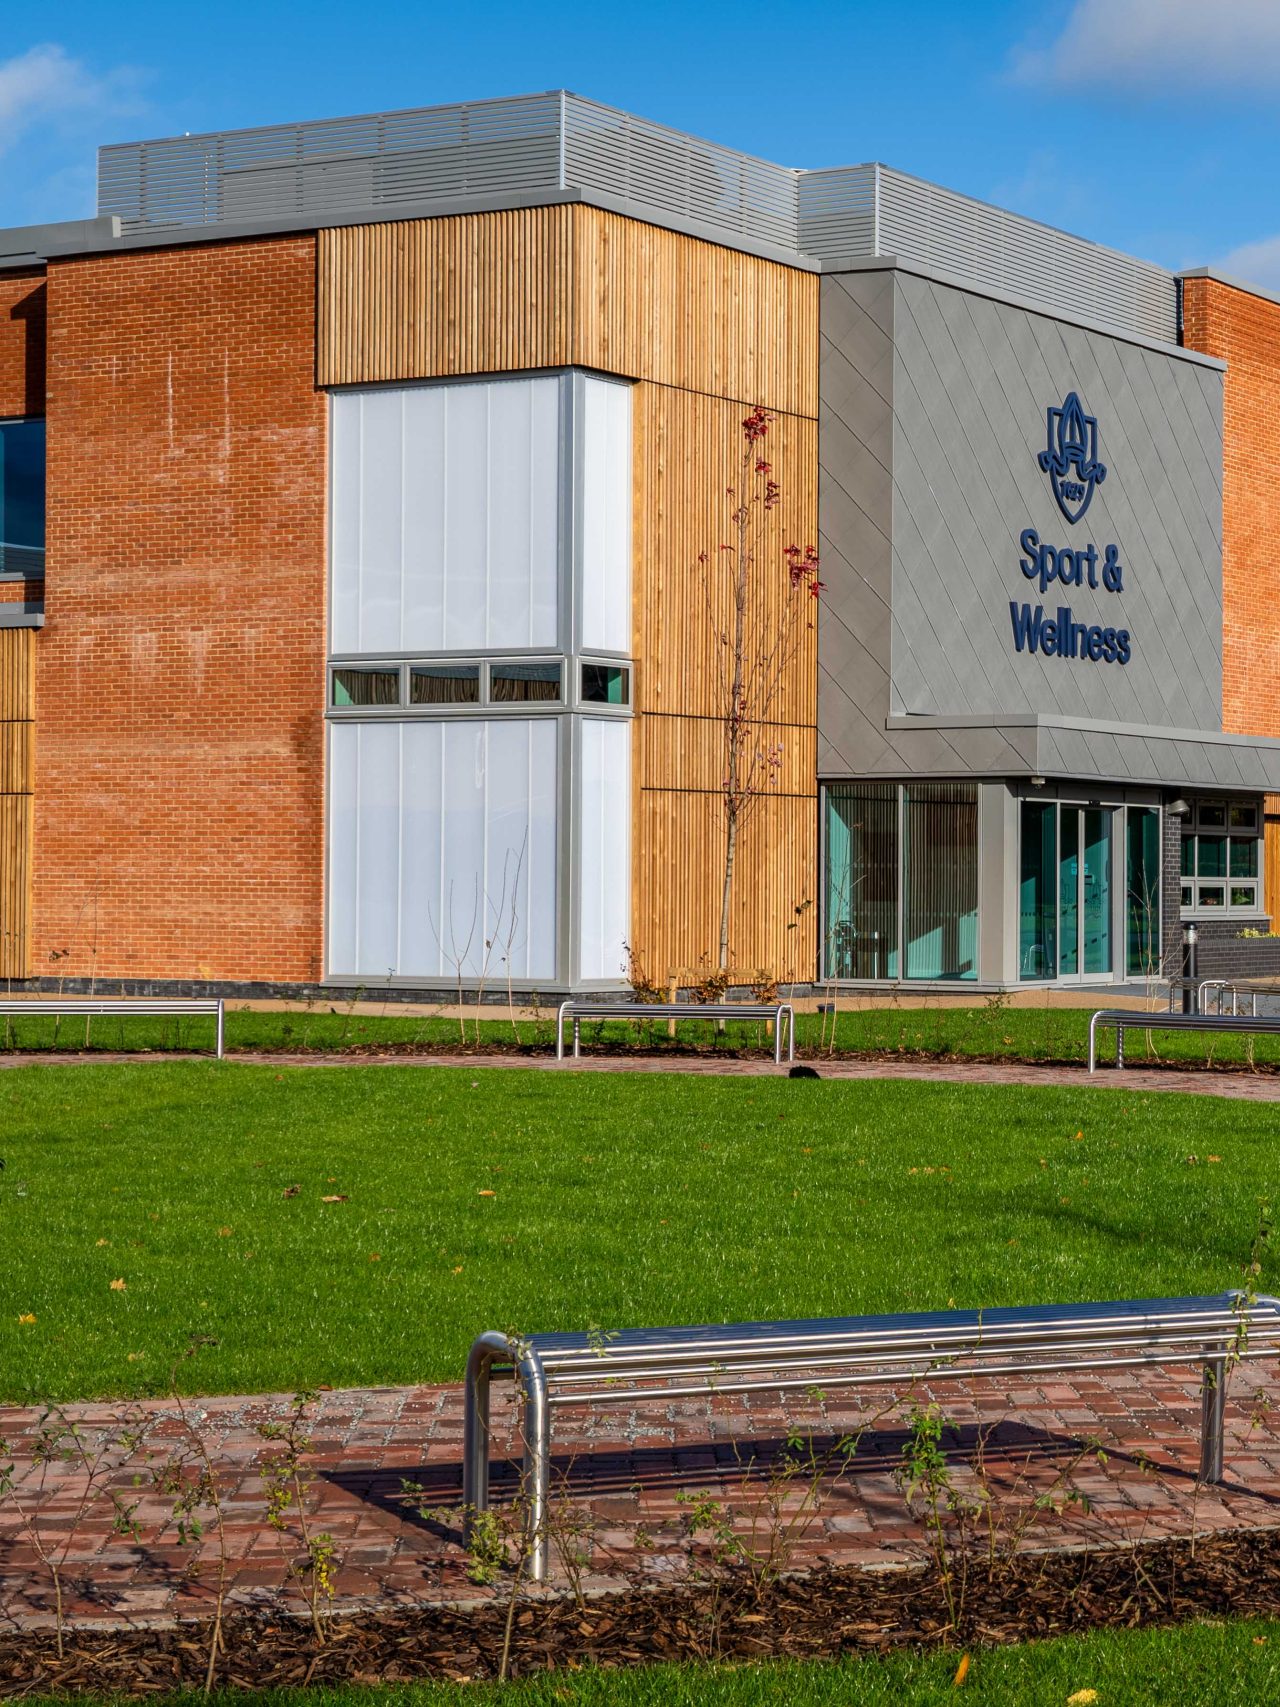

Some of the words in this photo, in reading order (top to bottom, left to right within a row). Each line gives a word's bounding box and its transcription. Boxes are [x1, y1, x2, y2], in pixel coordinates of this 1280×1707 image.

[1019, 528, 1099, 594] Sport
[1102, 543, 1124, 593] &
[1009, 601, 1131, 665] Wellness
